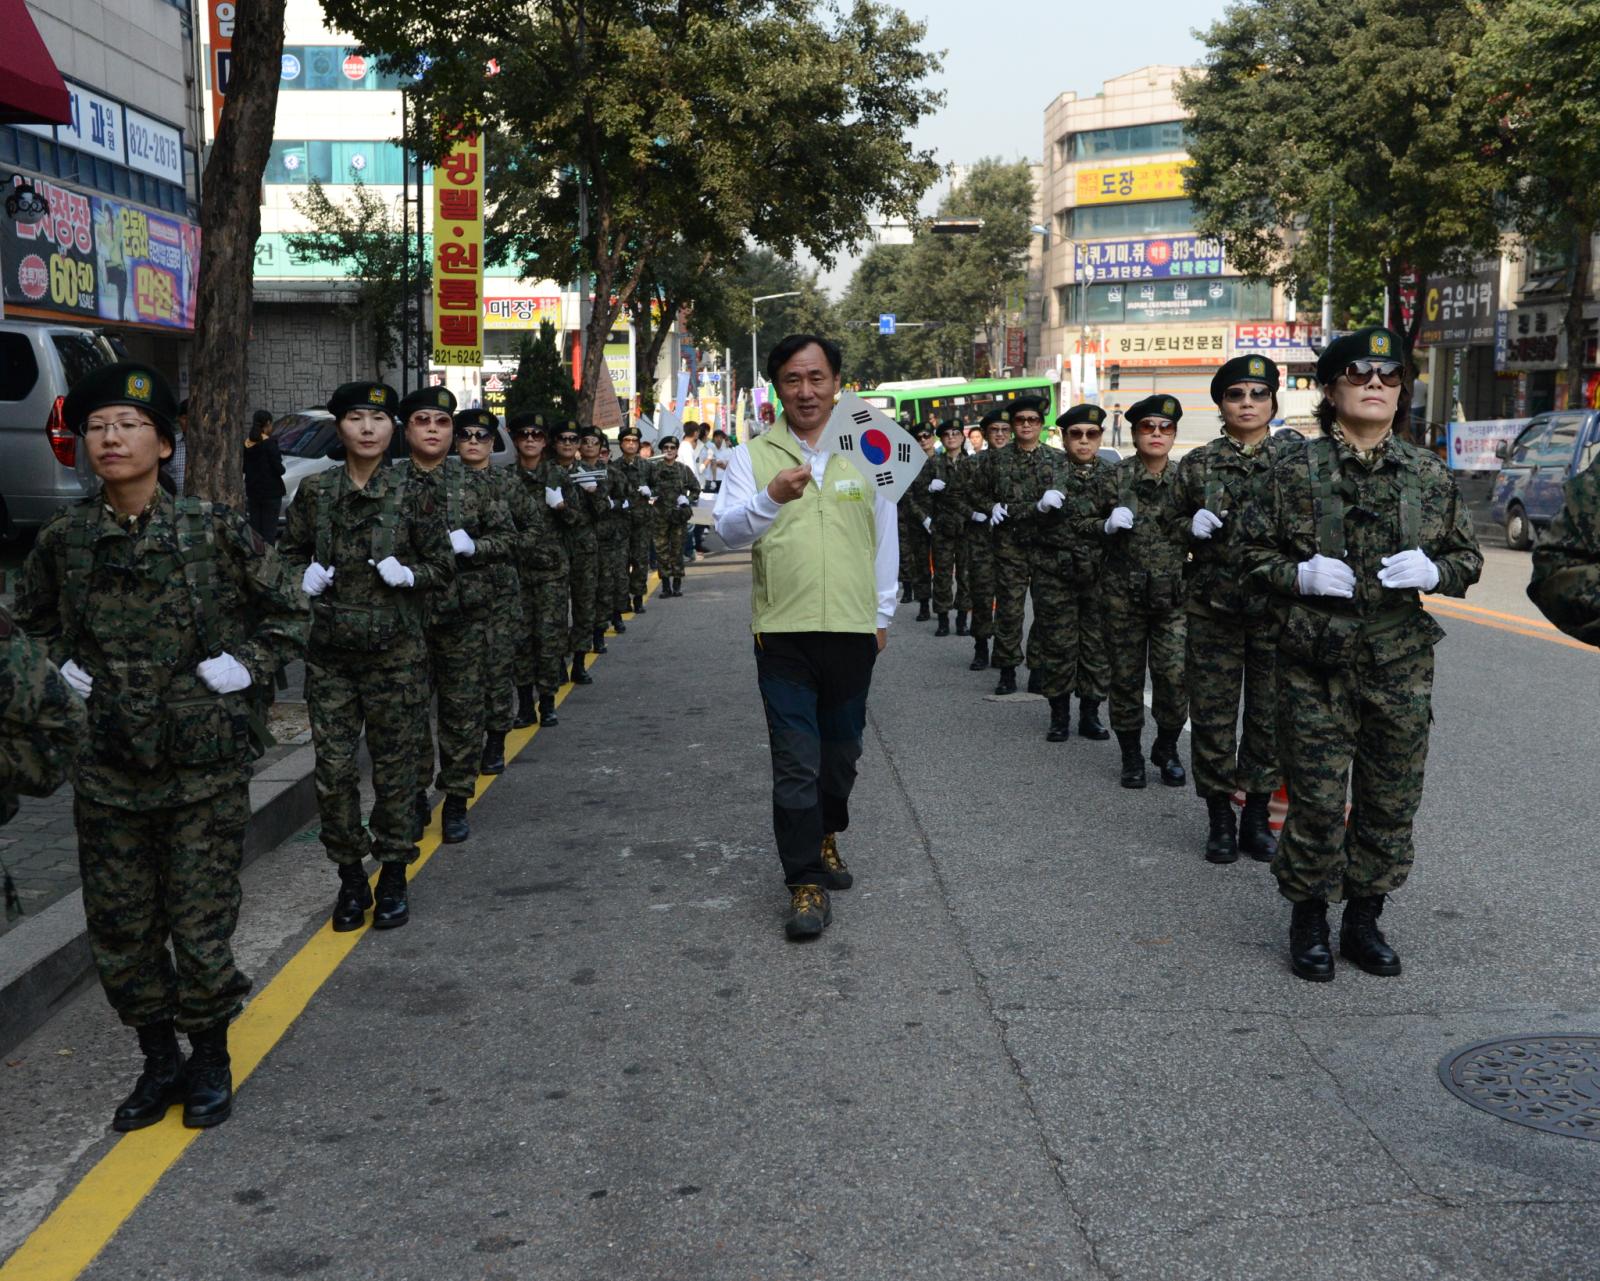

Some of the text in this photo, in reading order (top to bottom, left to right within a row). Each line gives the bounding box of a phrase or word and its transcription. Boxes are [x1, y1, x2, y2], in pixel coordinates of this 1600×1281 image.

[129, 122, 177, 170] 822-2875
[1101, 170, 1135, 196] 도장
[50, 253, 78, 307] 60
[490, 300, 536, 320] 매장
[1426, 288, 1439, 321] G
[1441, 281, 1493, 320] 금은나라
[434, 350, 482, 364] 821-6242
[1120, 335, 1224, 352] 잉크/토너전문점
